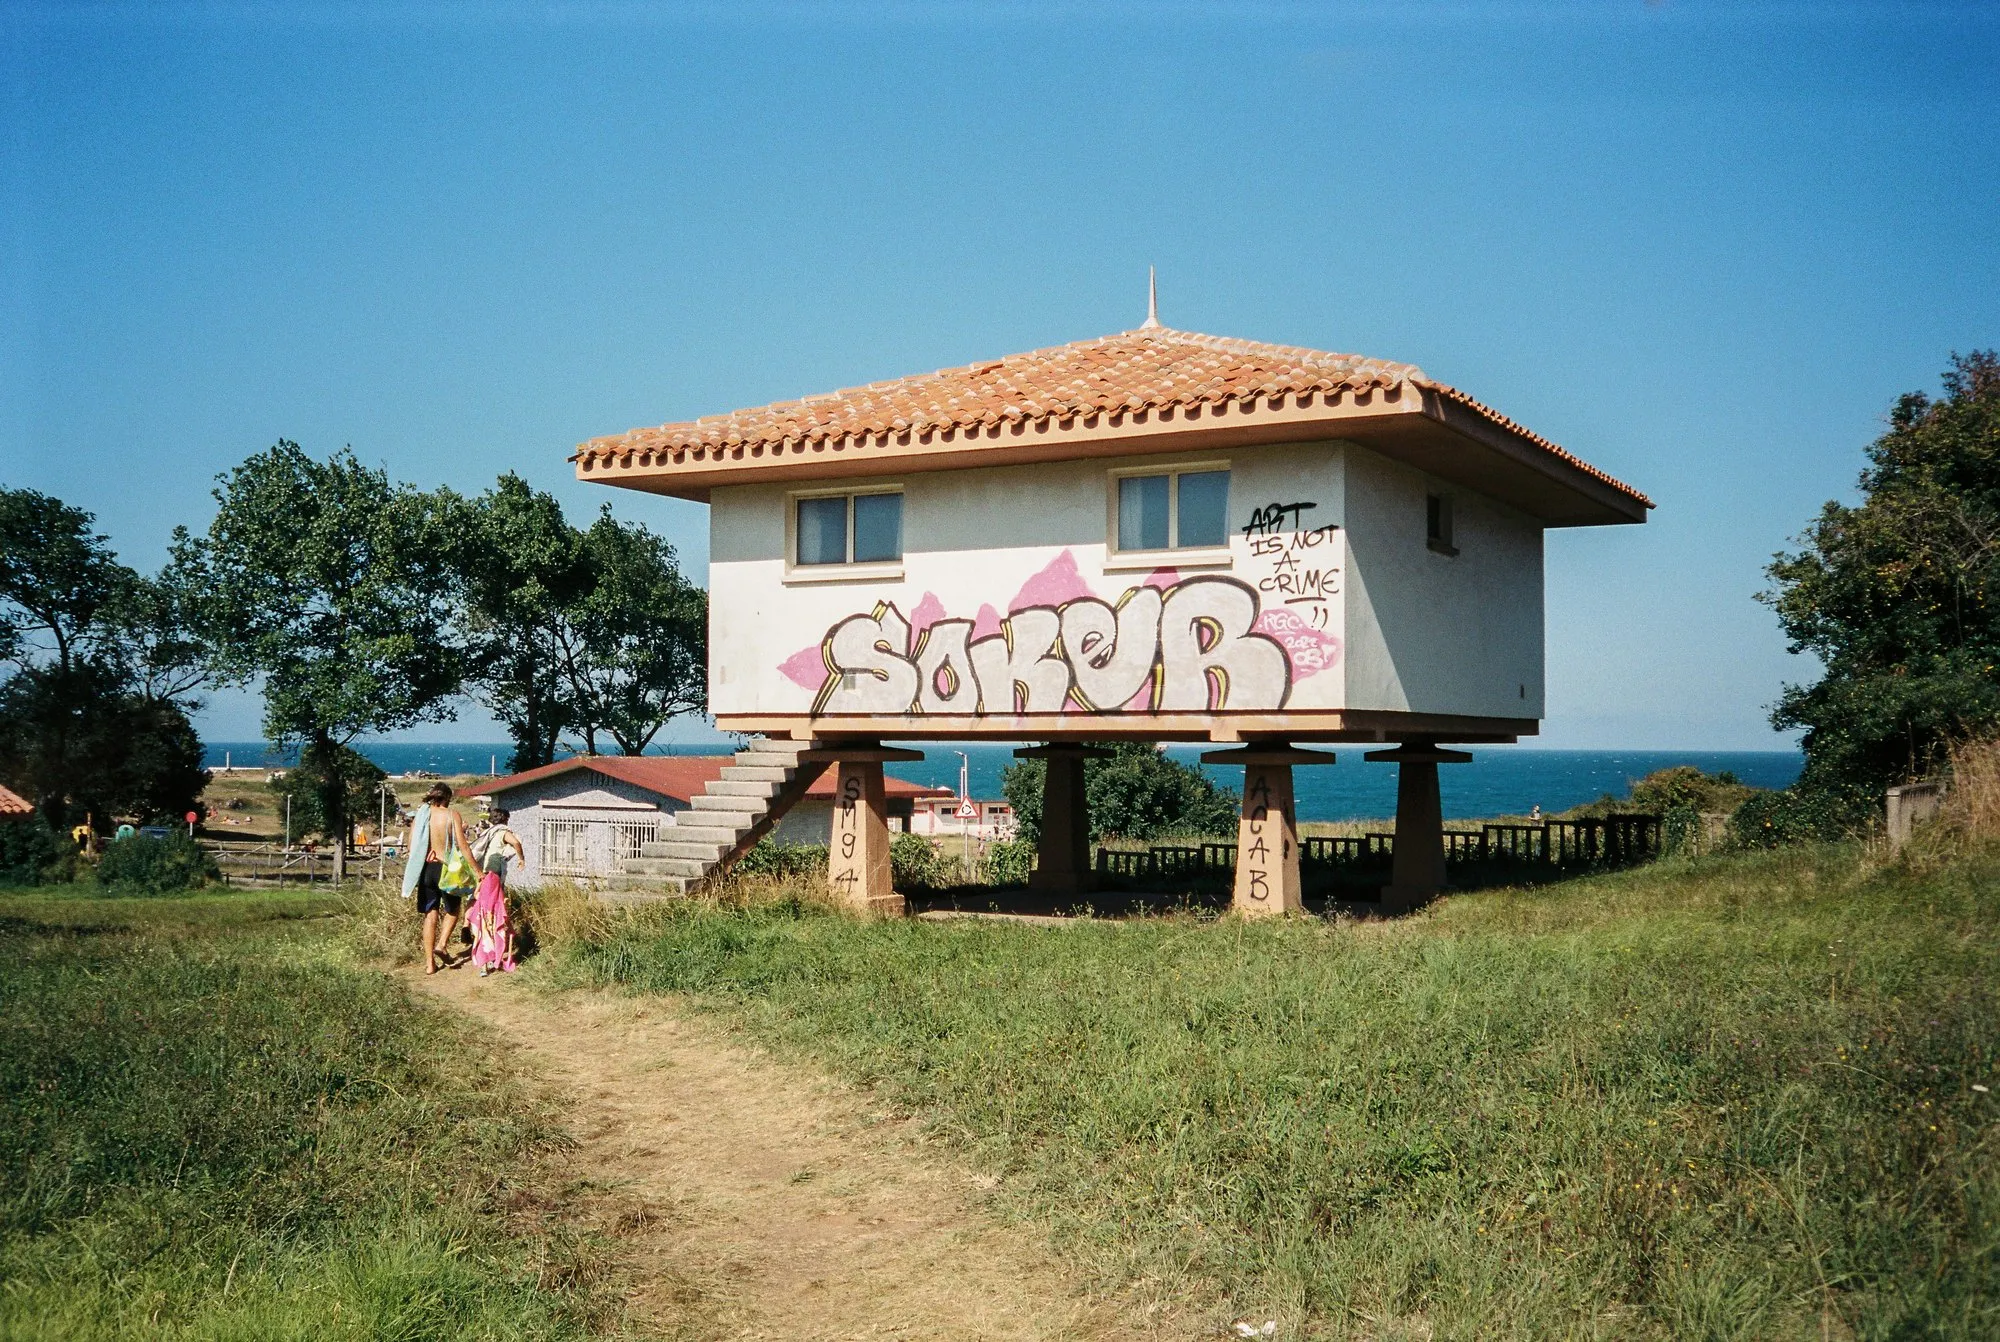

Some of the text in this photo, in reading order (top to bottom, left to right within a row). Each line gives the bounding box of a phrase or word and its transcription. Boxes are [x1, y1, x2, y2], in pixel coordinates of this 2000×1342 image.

[1242, 502, 1317, 541] ART
[1250, 525, 1339, 557] IS NOT
[1273, 551, 1300, 573] A
[1248, 776, 1270, 900] ACAB
